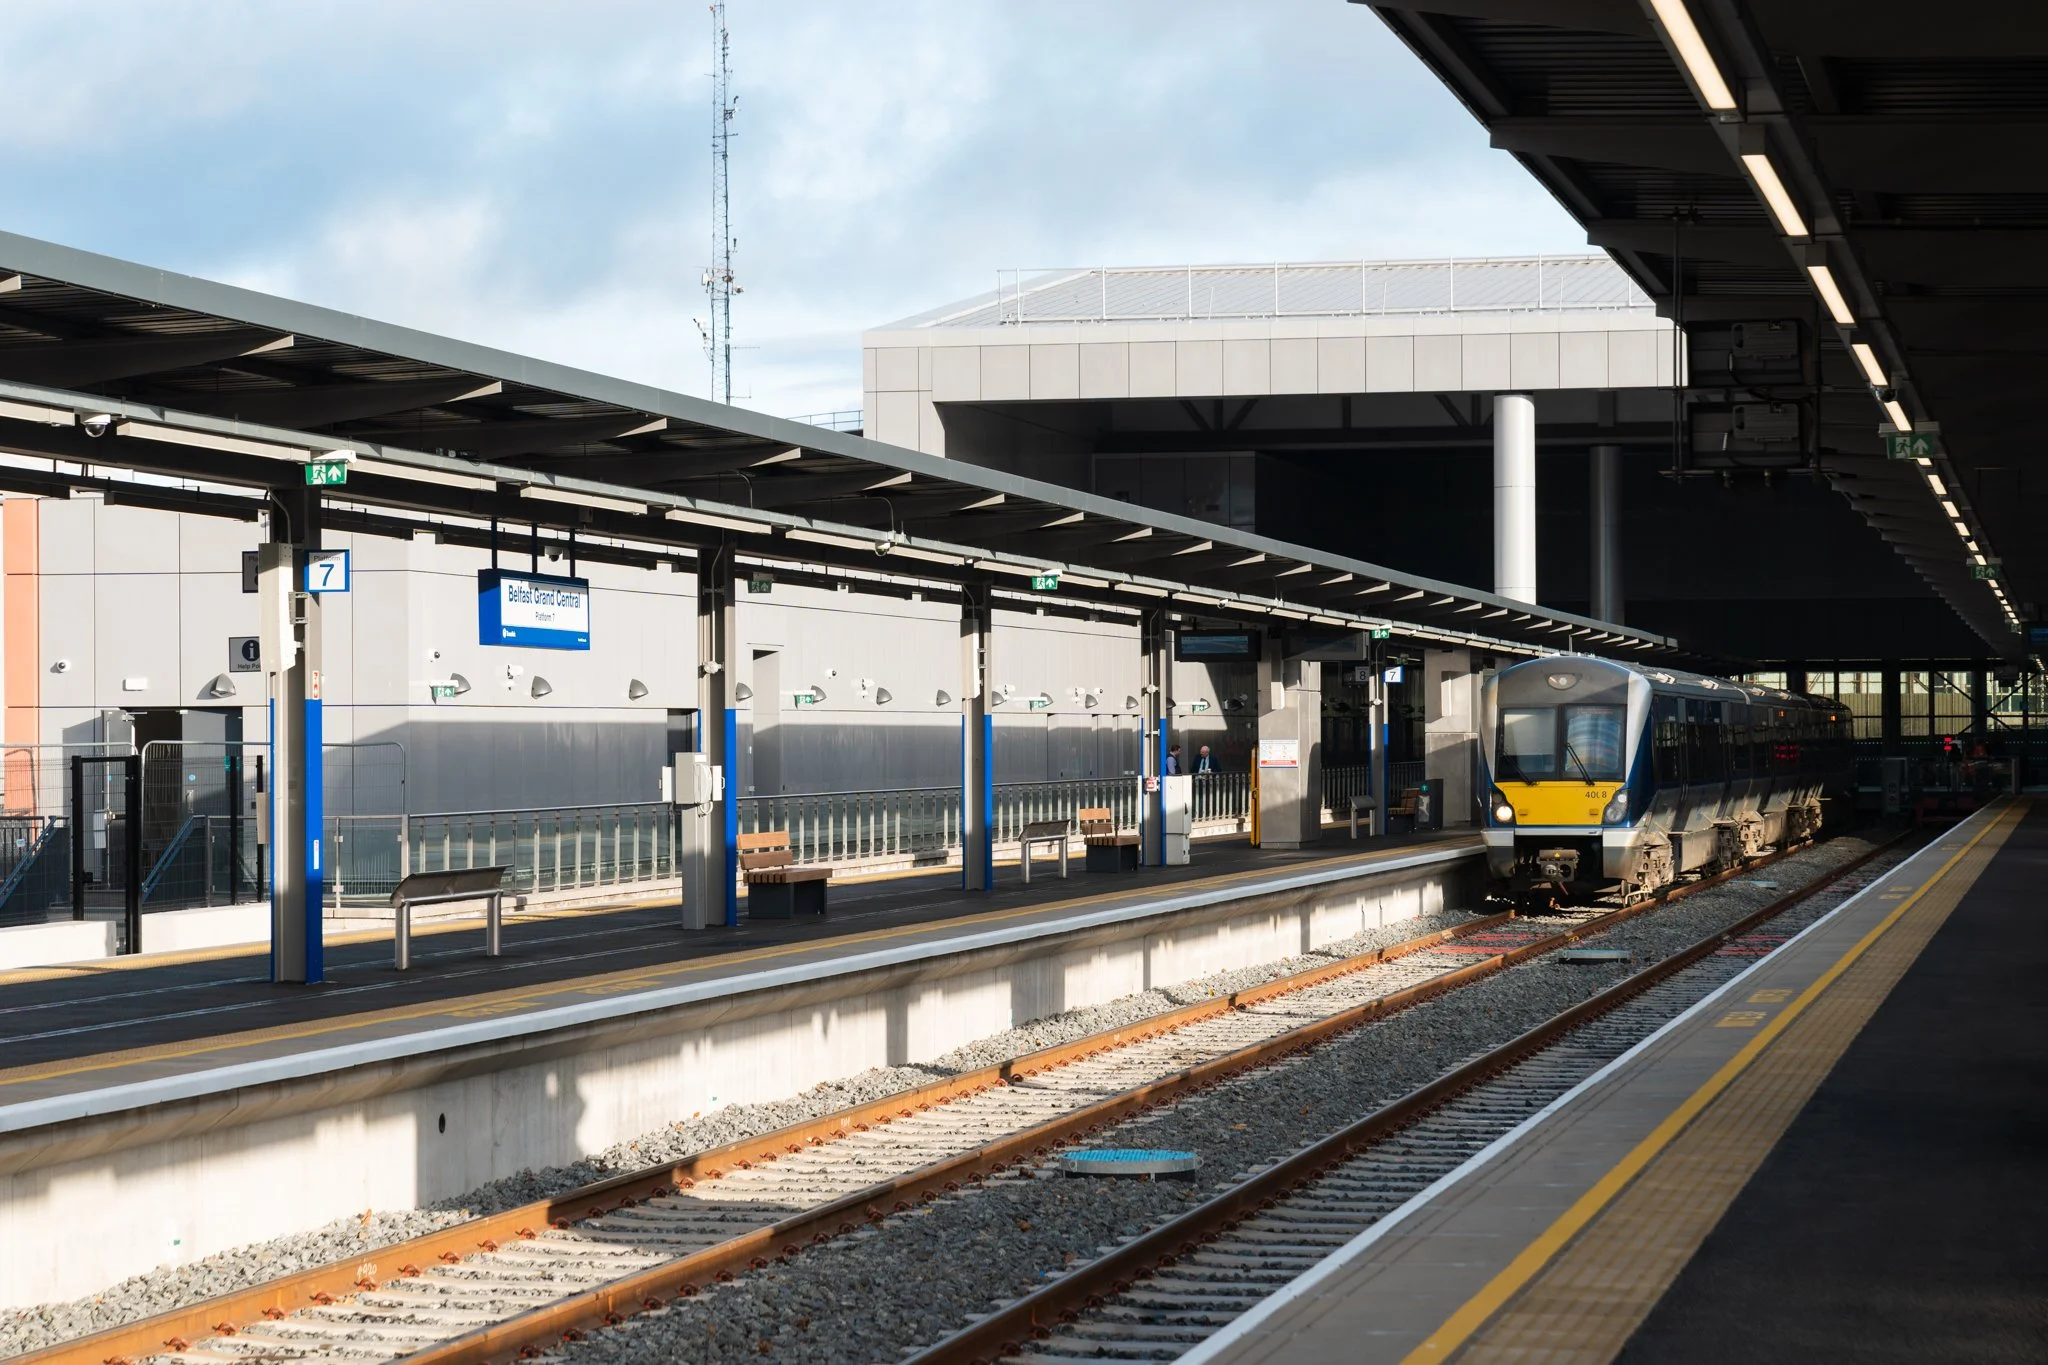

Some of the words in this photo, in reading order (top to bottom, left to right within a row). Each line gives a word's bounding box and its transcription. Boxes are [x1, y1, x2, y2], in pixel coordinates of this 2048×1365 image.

[320, 564, 334, 586] 7
[508, 585, 532, 603] Belfast
[534, 587, 555, 606] Grand
[557, 589, 581, 608] Central
[535, 611, 552, 622] Platform
[1360, 671, 1366, 680] 8
[1390, 671, 1396, 680] 7
